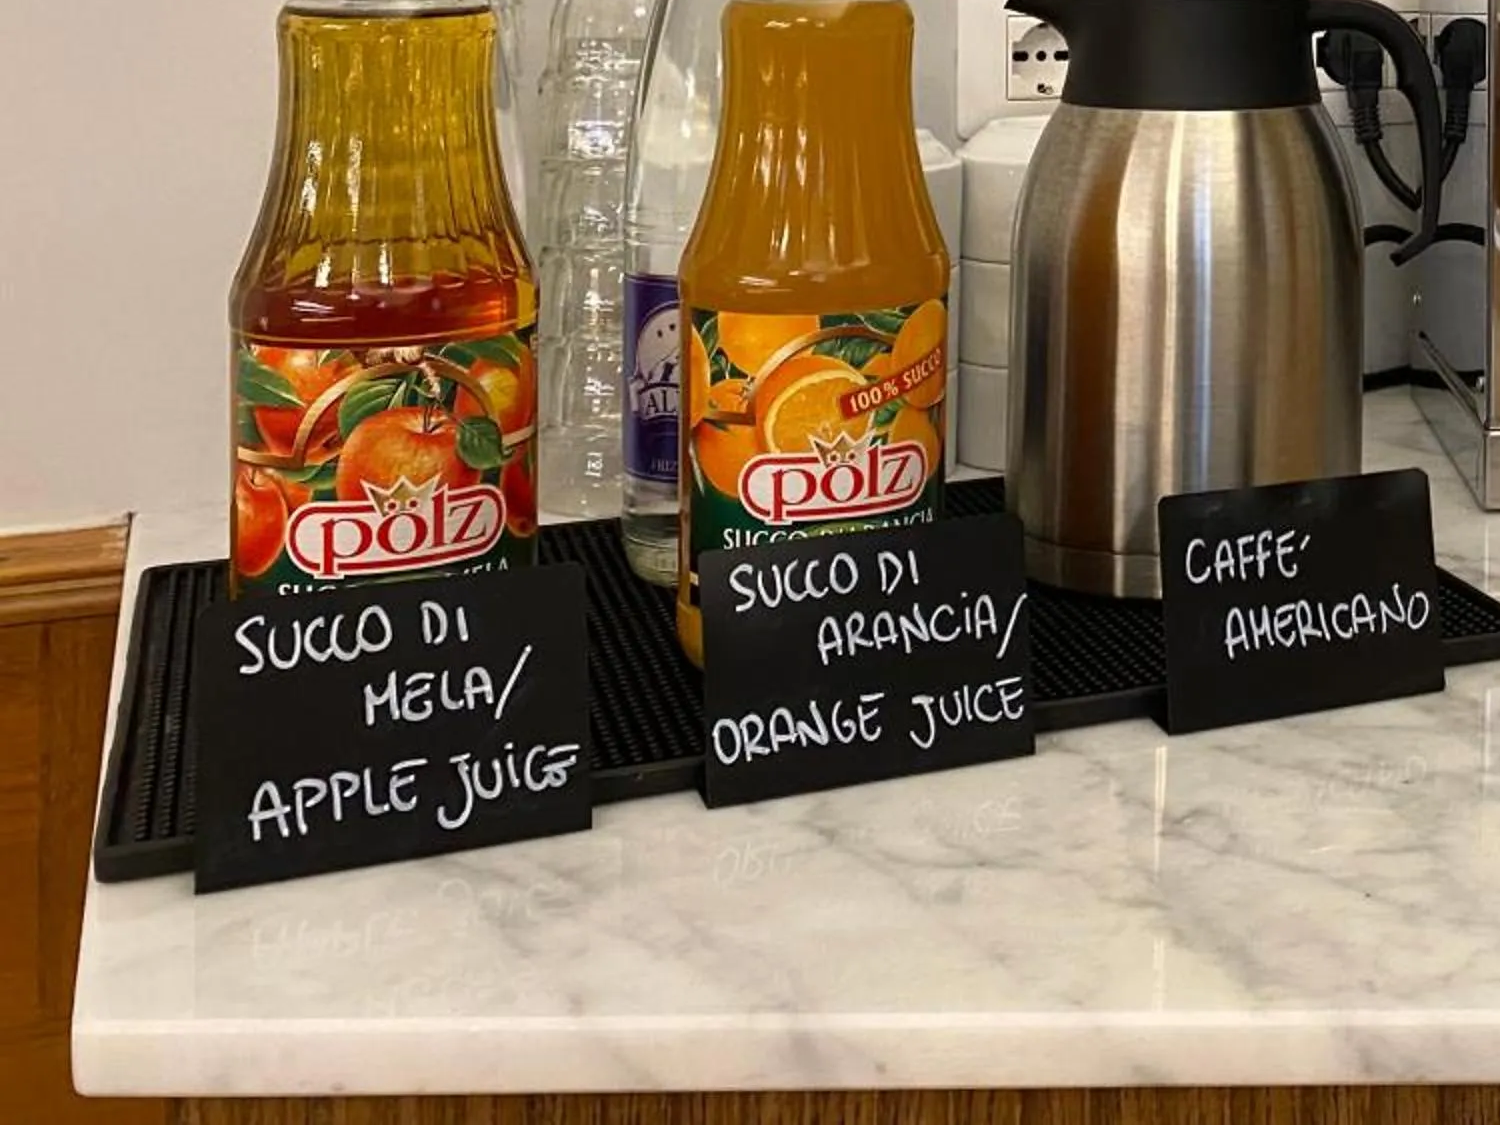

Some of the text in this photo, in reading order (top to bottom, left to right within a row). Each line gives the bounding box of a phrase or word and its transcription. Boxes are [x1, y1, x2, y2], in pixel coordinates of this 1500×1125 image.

[646, 390, 681, 415] AL
[772, 447, 914, 522] pölz
[321, 487, 487, 576] pölz
[728, 550, 920, 614] SUCCO DI
[1224, 582, 1430, 660] AMERICANO
[234, 601, 471, 676] SUCCO DI
[362, 644, 533, 728] MELA/
[710, 676, 1025, 767] ORANGE JUICE
[247, 757, 428, 842] APPLE
